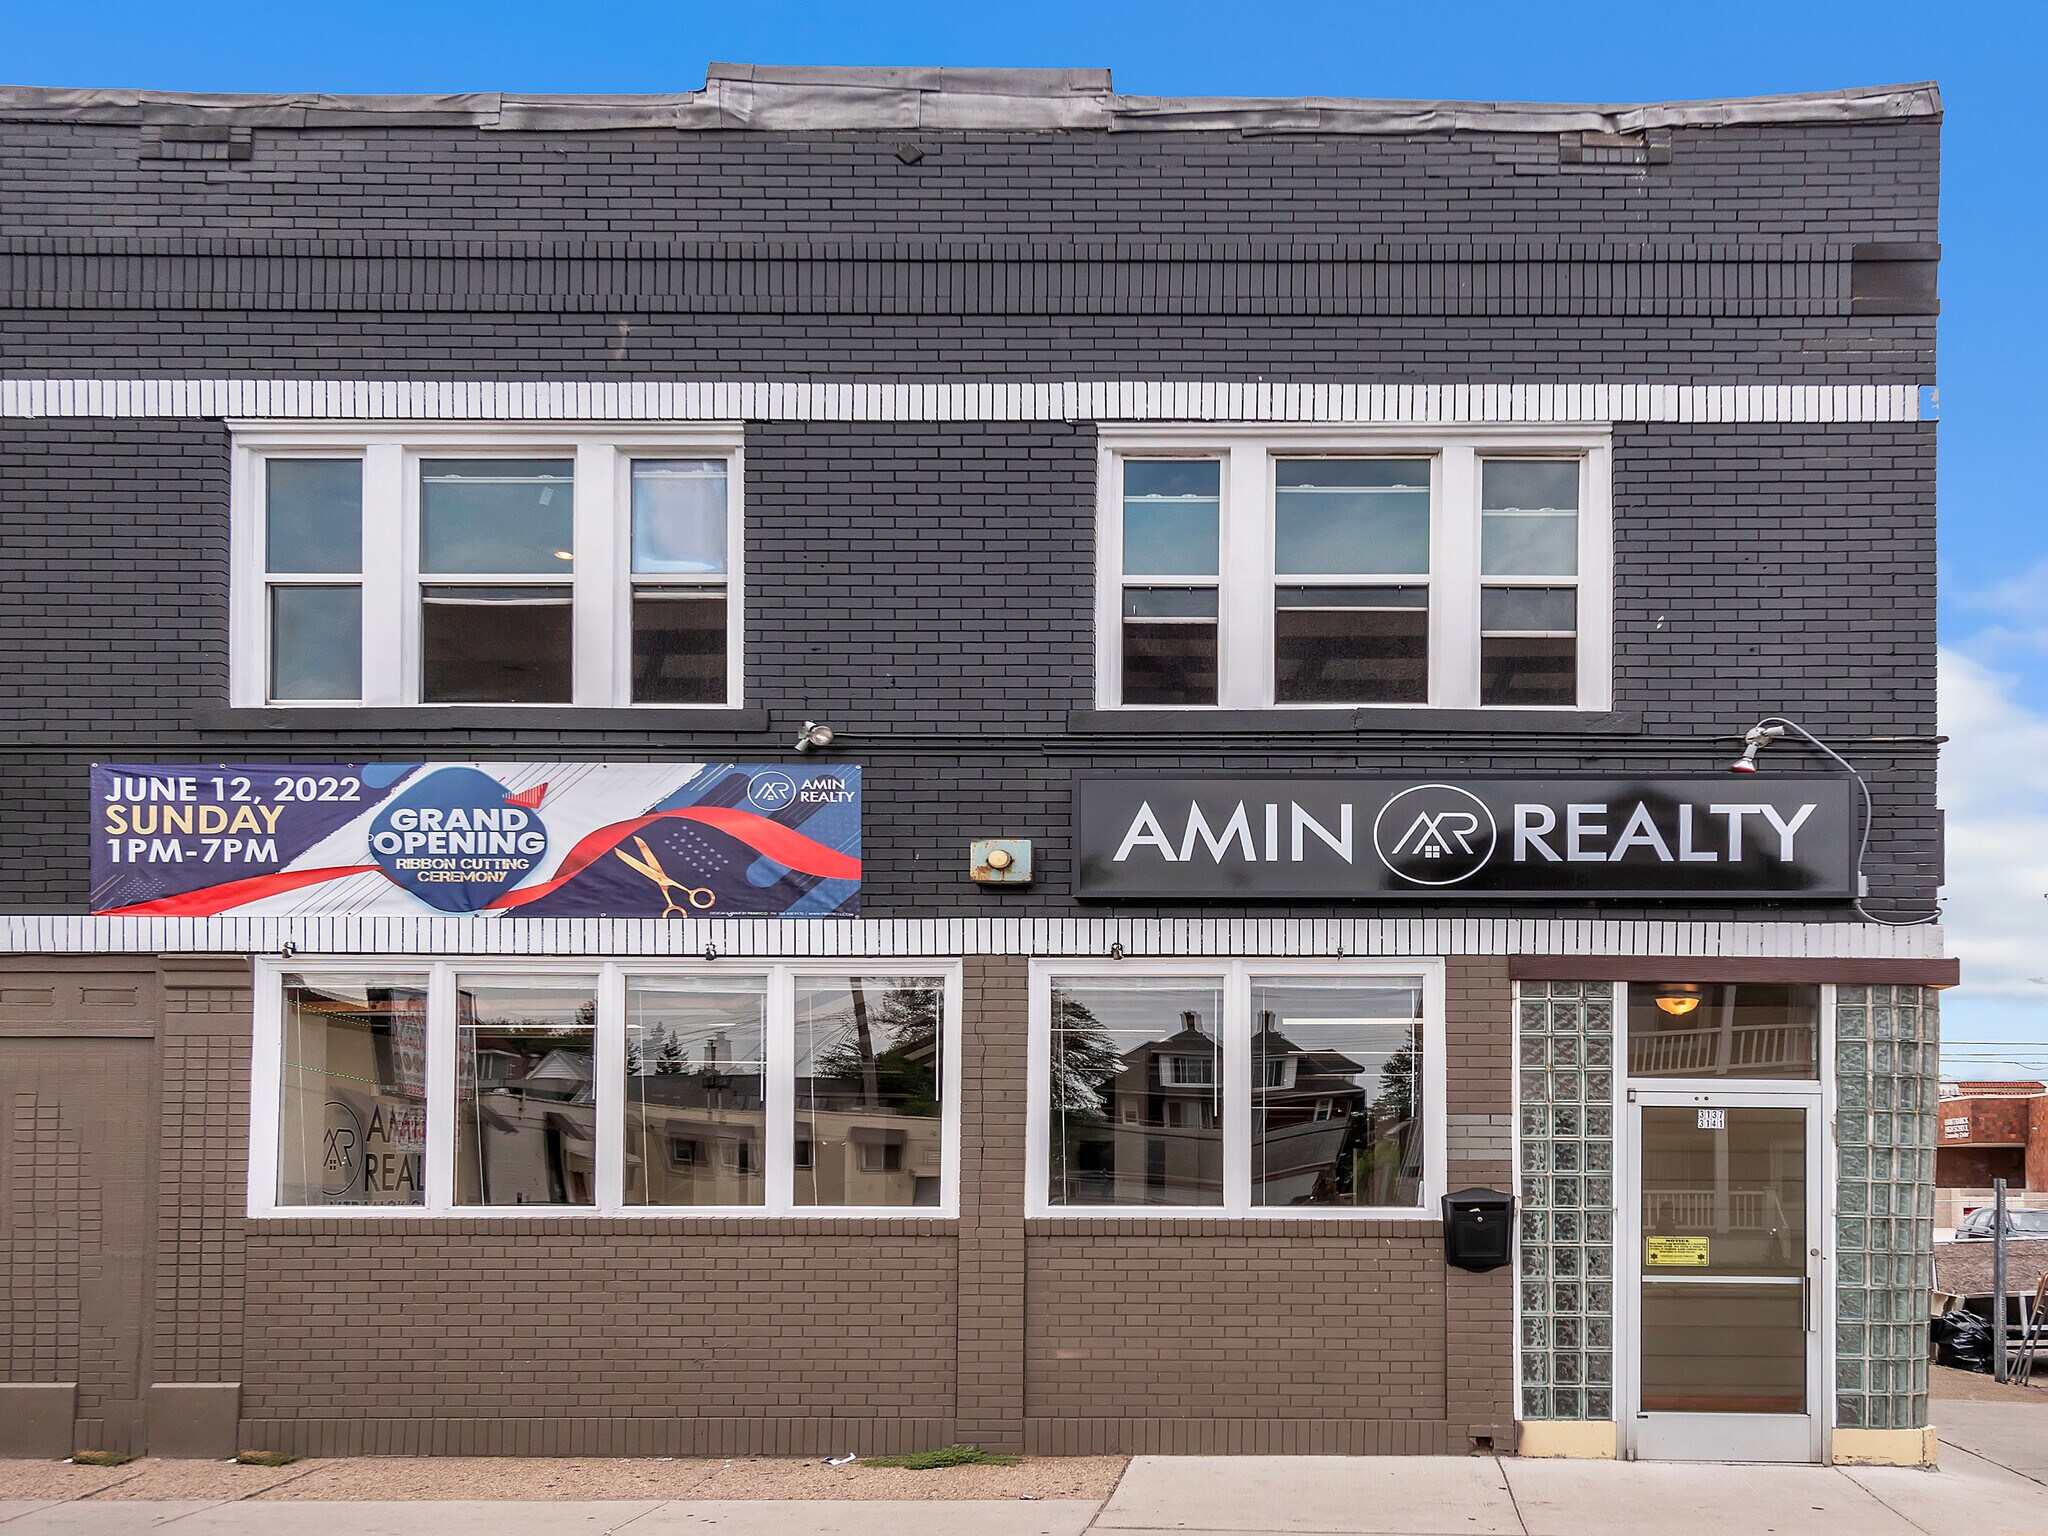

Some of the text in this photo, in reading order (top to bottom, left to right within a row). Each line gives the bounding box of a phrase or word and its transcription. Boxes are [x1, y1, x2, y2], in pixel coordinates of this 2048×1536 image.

[104, 777, 361, 804] JUNE 12, 2022
[801, 779, 846, 790] AMIN
[800, 791, 856, 803] REALTY
[104, 805, 286, 835] SUNDAY
[390, 808, 529, 832] GRAND
[1112, 799, 1354, 865] AMIN
[1513, 799, 1818, 863] REALTY
[106, 838, 280, 863] 1PM-7PM
[372, 831, 546, 855] OPENING
[395, 858, 530, 870] RIBBON CUTTING
[416, 871, 509, 883] CEREMONY
[1698, 1119, 1723, 1128] 3141
[1699, 1110, 1724, 1119] 3137
